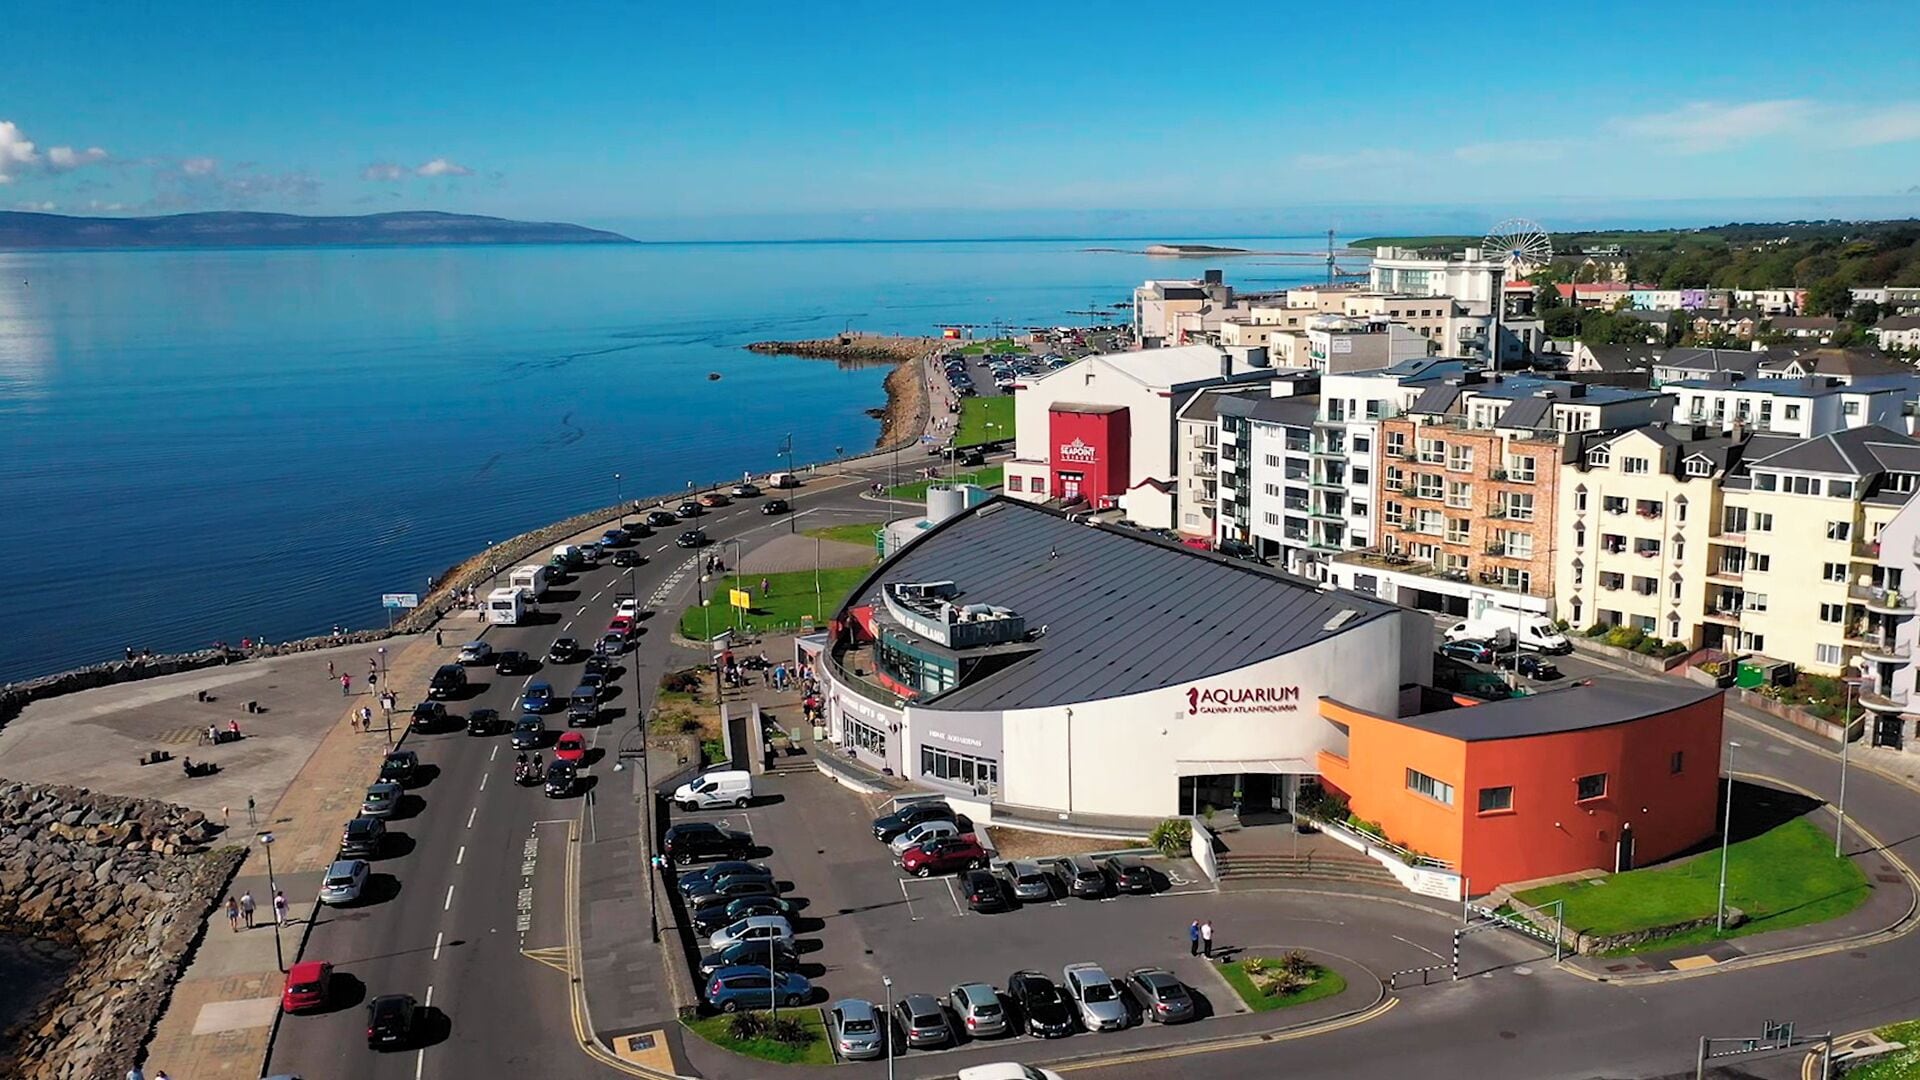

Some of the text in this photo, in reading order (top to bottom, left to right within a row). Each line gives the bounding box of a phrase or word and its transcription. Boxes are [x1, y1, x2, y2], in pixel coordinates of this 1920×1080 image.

[1060, 444, 1095, 457] SEAPOINT
[915, 621, 946, 644] IRELAND
[1201, 687, 1298, 705] AQUARIUM
[1200, 706, 1232, 714] GALWAY
